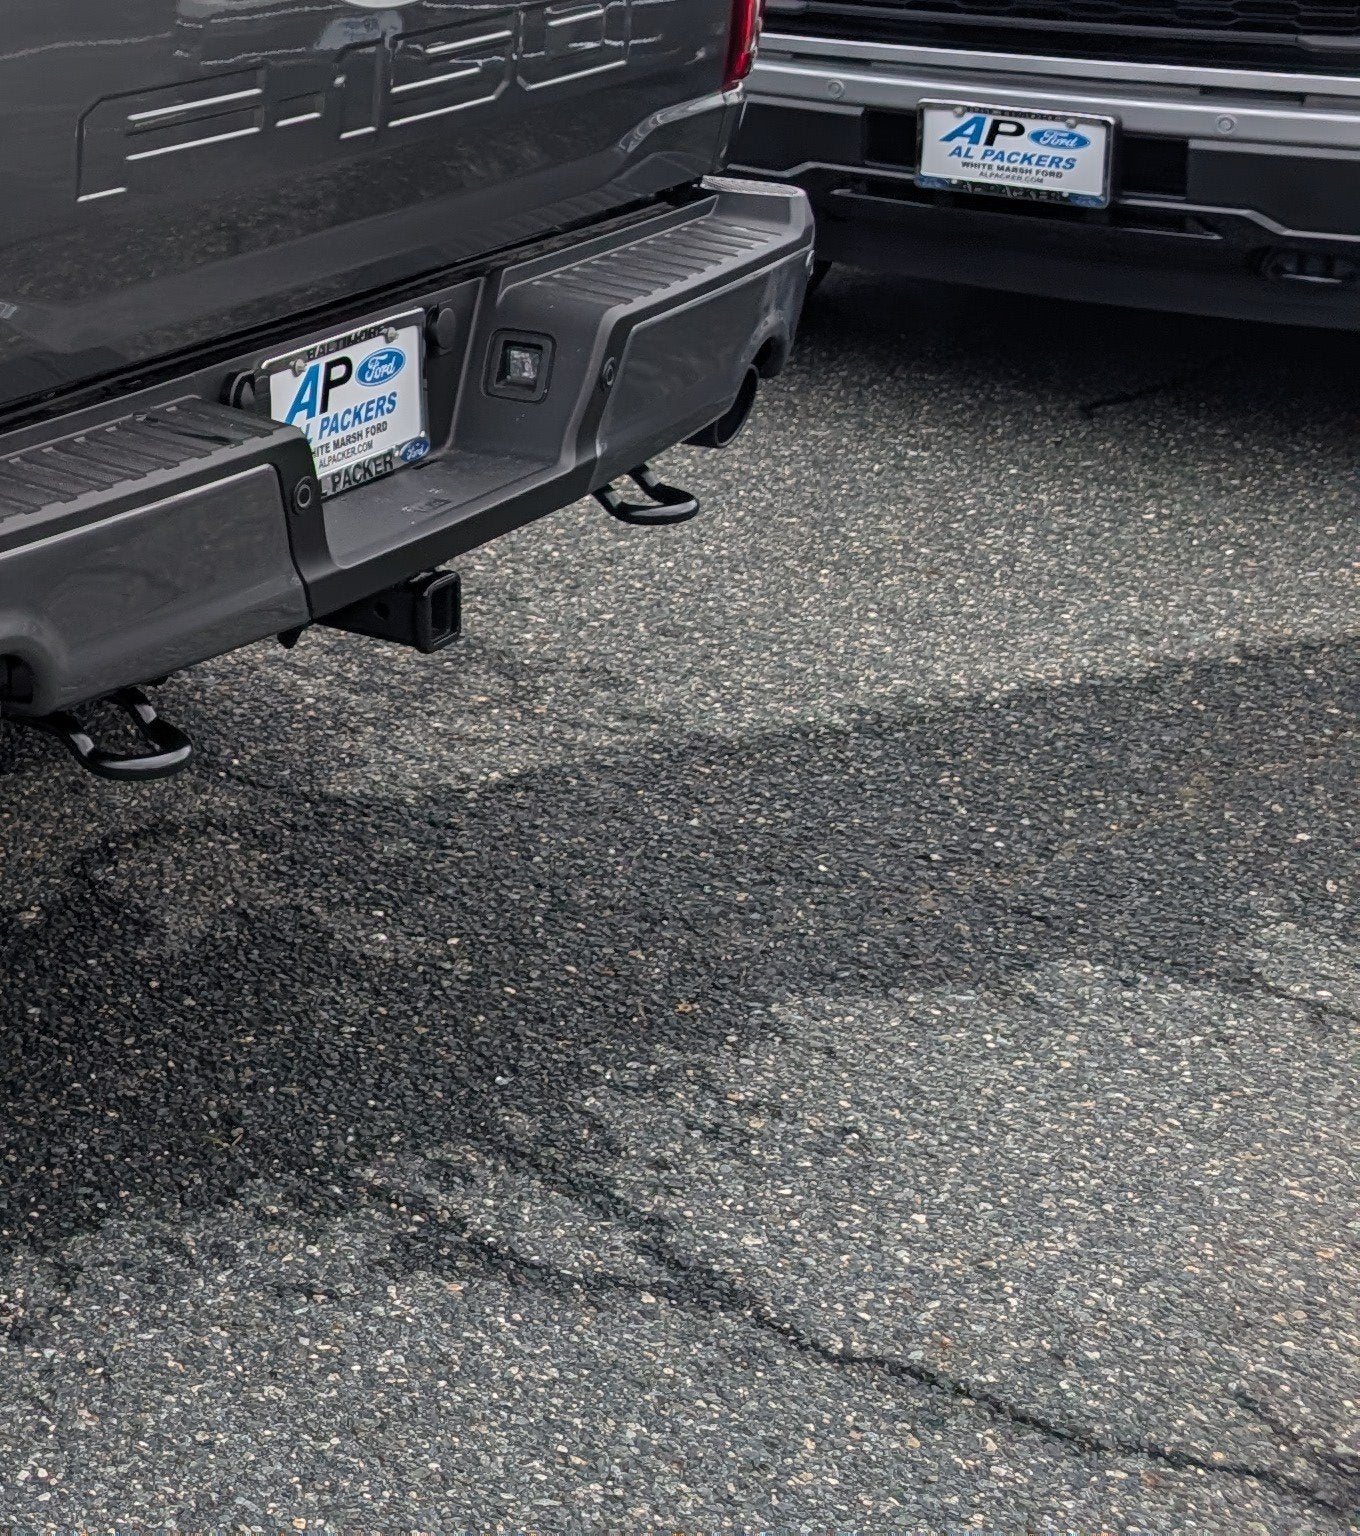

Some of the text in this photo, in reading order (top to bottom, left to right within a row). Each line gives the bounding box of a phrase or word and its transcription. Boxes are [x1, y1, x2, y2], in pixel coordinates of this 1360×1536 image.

[939, 114, 1026, 147] AP
[1039, 129, 1079, 148] Ford
[948, 146, 1078, 170] AL PACKERS
[961, 161, 1063, 179] WHITE MARSH FORD
[284, 352, 397, 425] AP Ford
[317, 391, 398, 441] PACKERS
[332, 430, 364, 451] MARSH
[365, 420, 388, 439] FORD
[330, 451, 394, 493] PACKER
